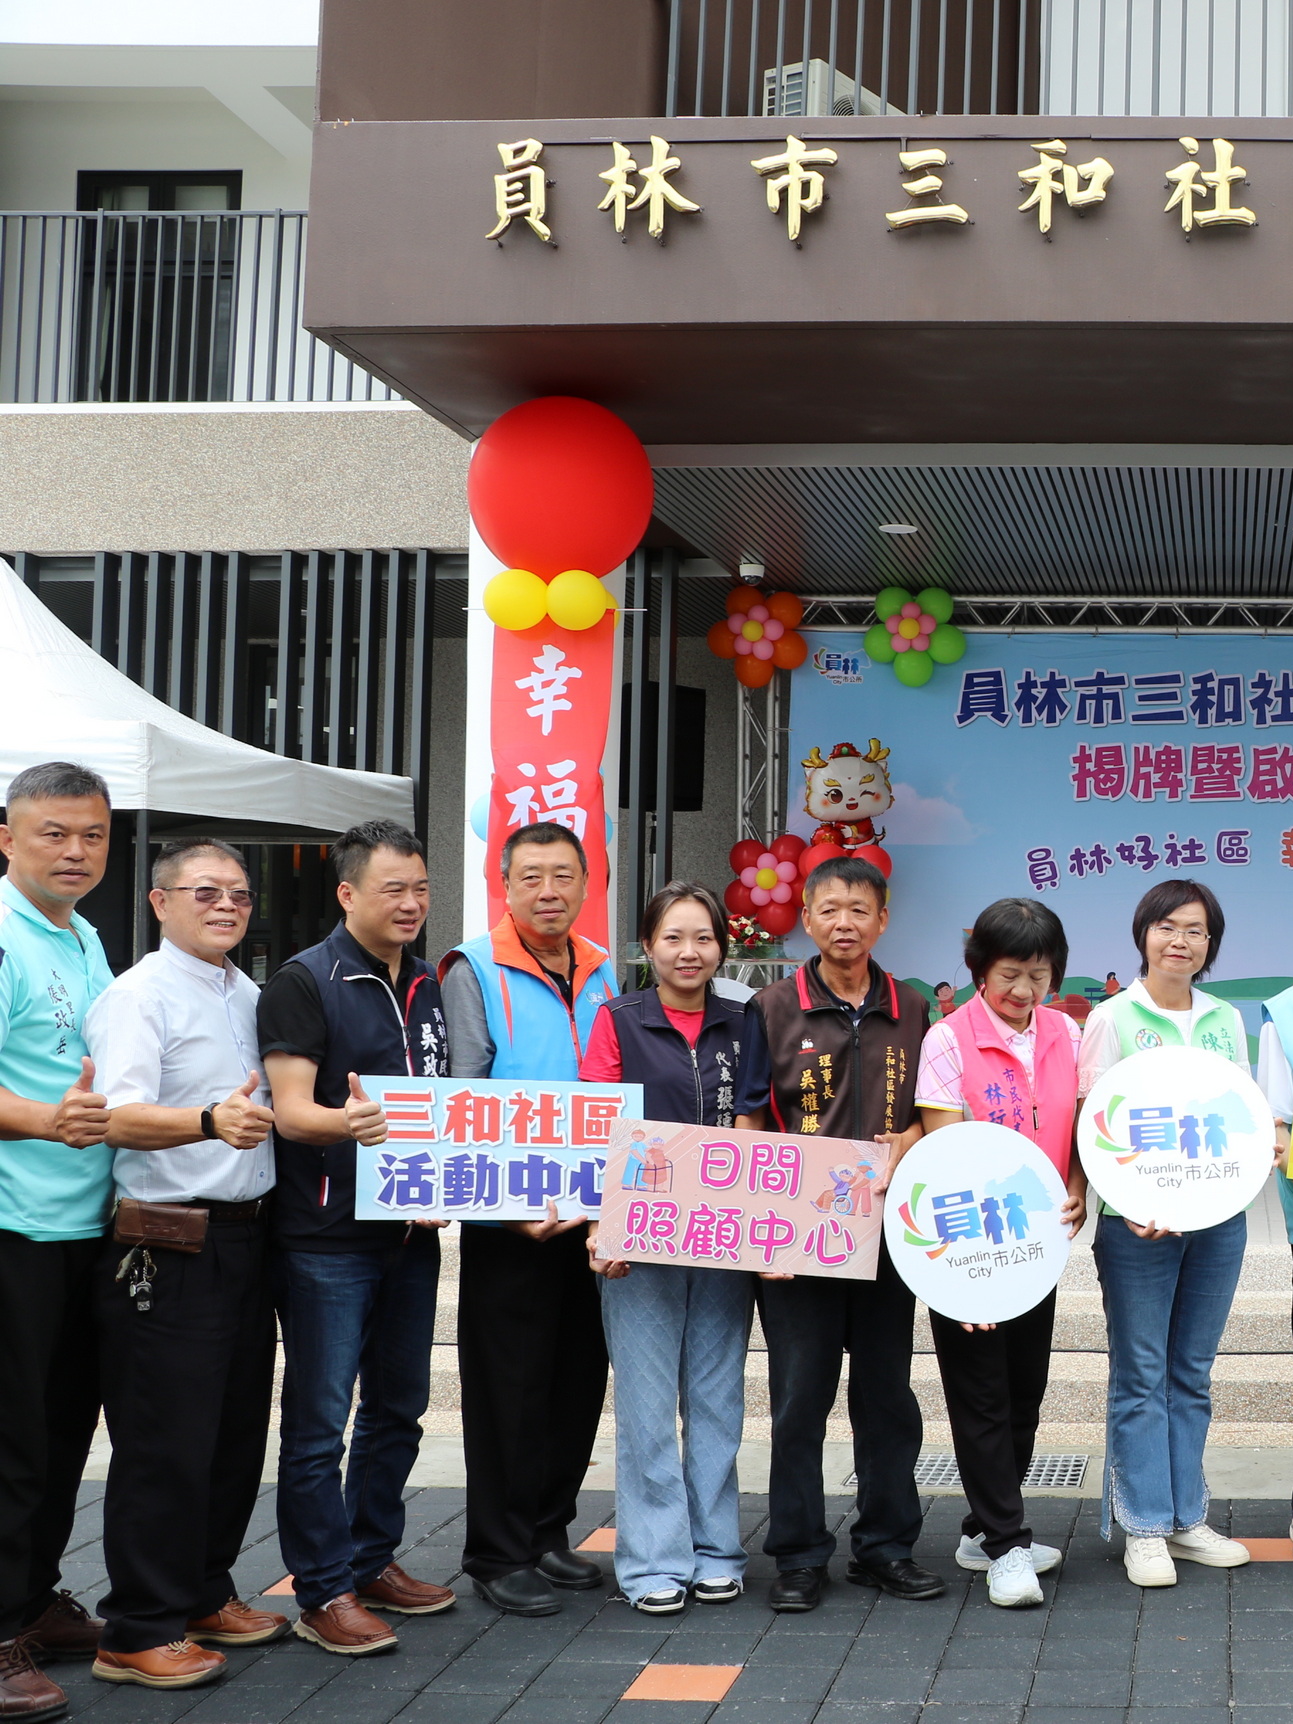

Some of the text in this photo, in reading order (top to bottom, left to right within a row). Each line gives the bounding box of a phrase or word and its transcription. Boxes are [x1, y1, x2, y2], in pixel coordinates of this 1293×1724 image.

[826, 654, 860, 675] 員林
[505, 644, 588, 842] 幸福
[1026, 829, 1251, 890] 員林好社區
[799, 1068, 821, 1134] 吳權勝
[818, 1053, 836, 1100] 理事長
[383, 1089, 622, 1145] 三和社區
[1128, 1106, 1229, 1159] 員林
[699, 1141, 802, 1199] 日間
[1135, 1162, 1183, 1175] Yuanlin
[1156, 1176, 1183, 1189] City
[1184, 1161, 1240, 1181] 市公所
[622, 1200, 855, 1265] 照顧中心
[931, 1190, 1030, 1246] 員林
[945, 1250, 991, 1269] Yuanlin
[968, 1265, 993, 1279] City
[992, 1242, 1045, 1269] 市公所
